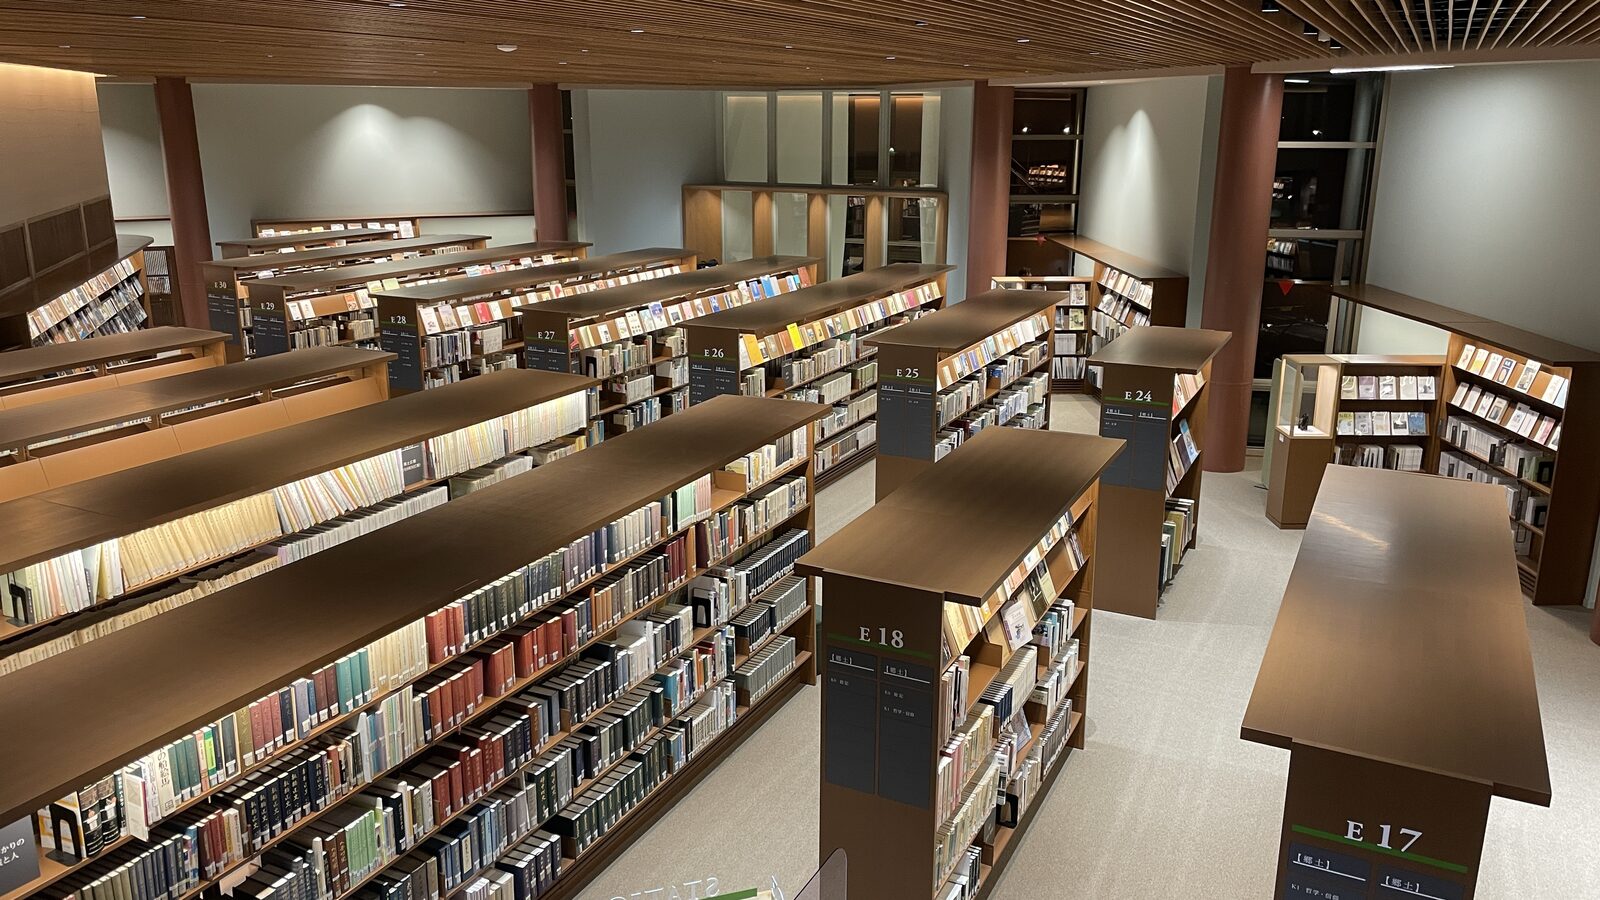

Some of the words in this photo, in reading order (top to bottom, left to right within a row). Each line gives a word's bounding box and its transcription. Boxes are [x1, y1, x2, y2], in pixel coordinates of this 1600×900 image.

[266, 302, 275, 310] 29
[397, 315, 407, 325] 28
[544, 331, 555, 340] 27
[704, 349, 710, 357] E
[711, 348, 724, 358] 26
[896, 369, 902, 377] E
[905, 368, 919, 378] 25
[1124, 391, 1132, 400] E
[1135, 390, 1152, 402] 24
[859, 626, 871, 642] E
[878, 627, 904, 649] 18
[1344, 820, 1364, 842] E
[1376, 824, 1423, 852] 17
